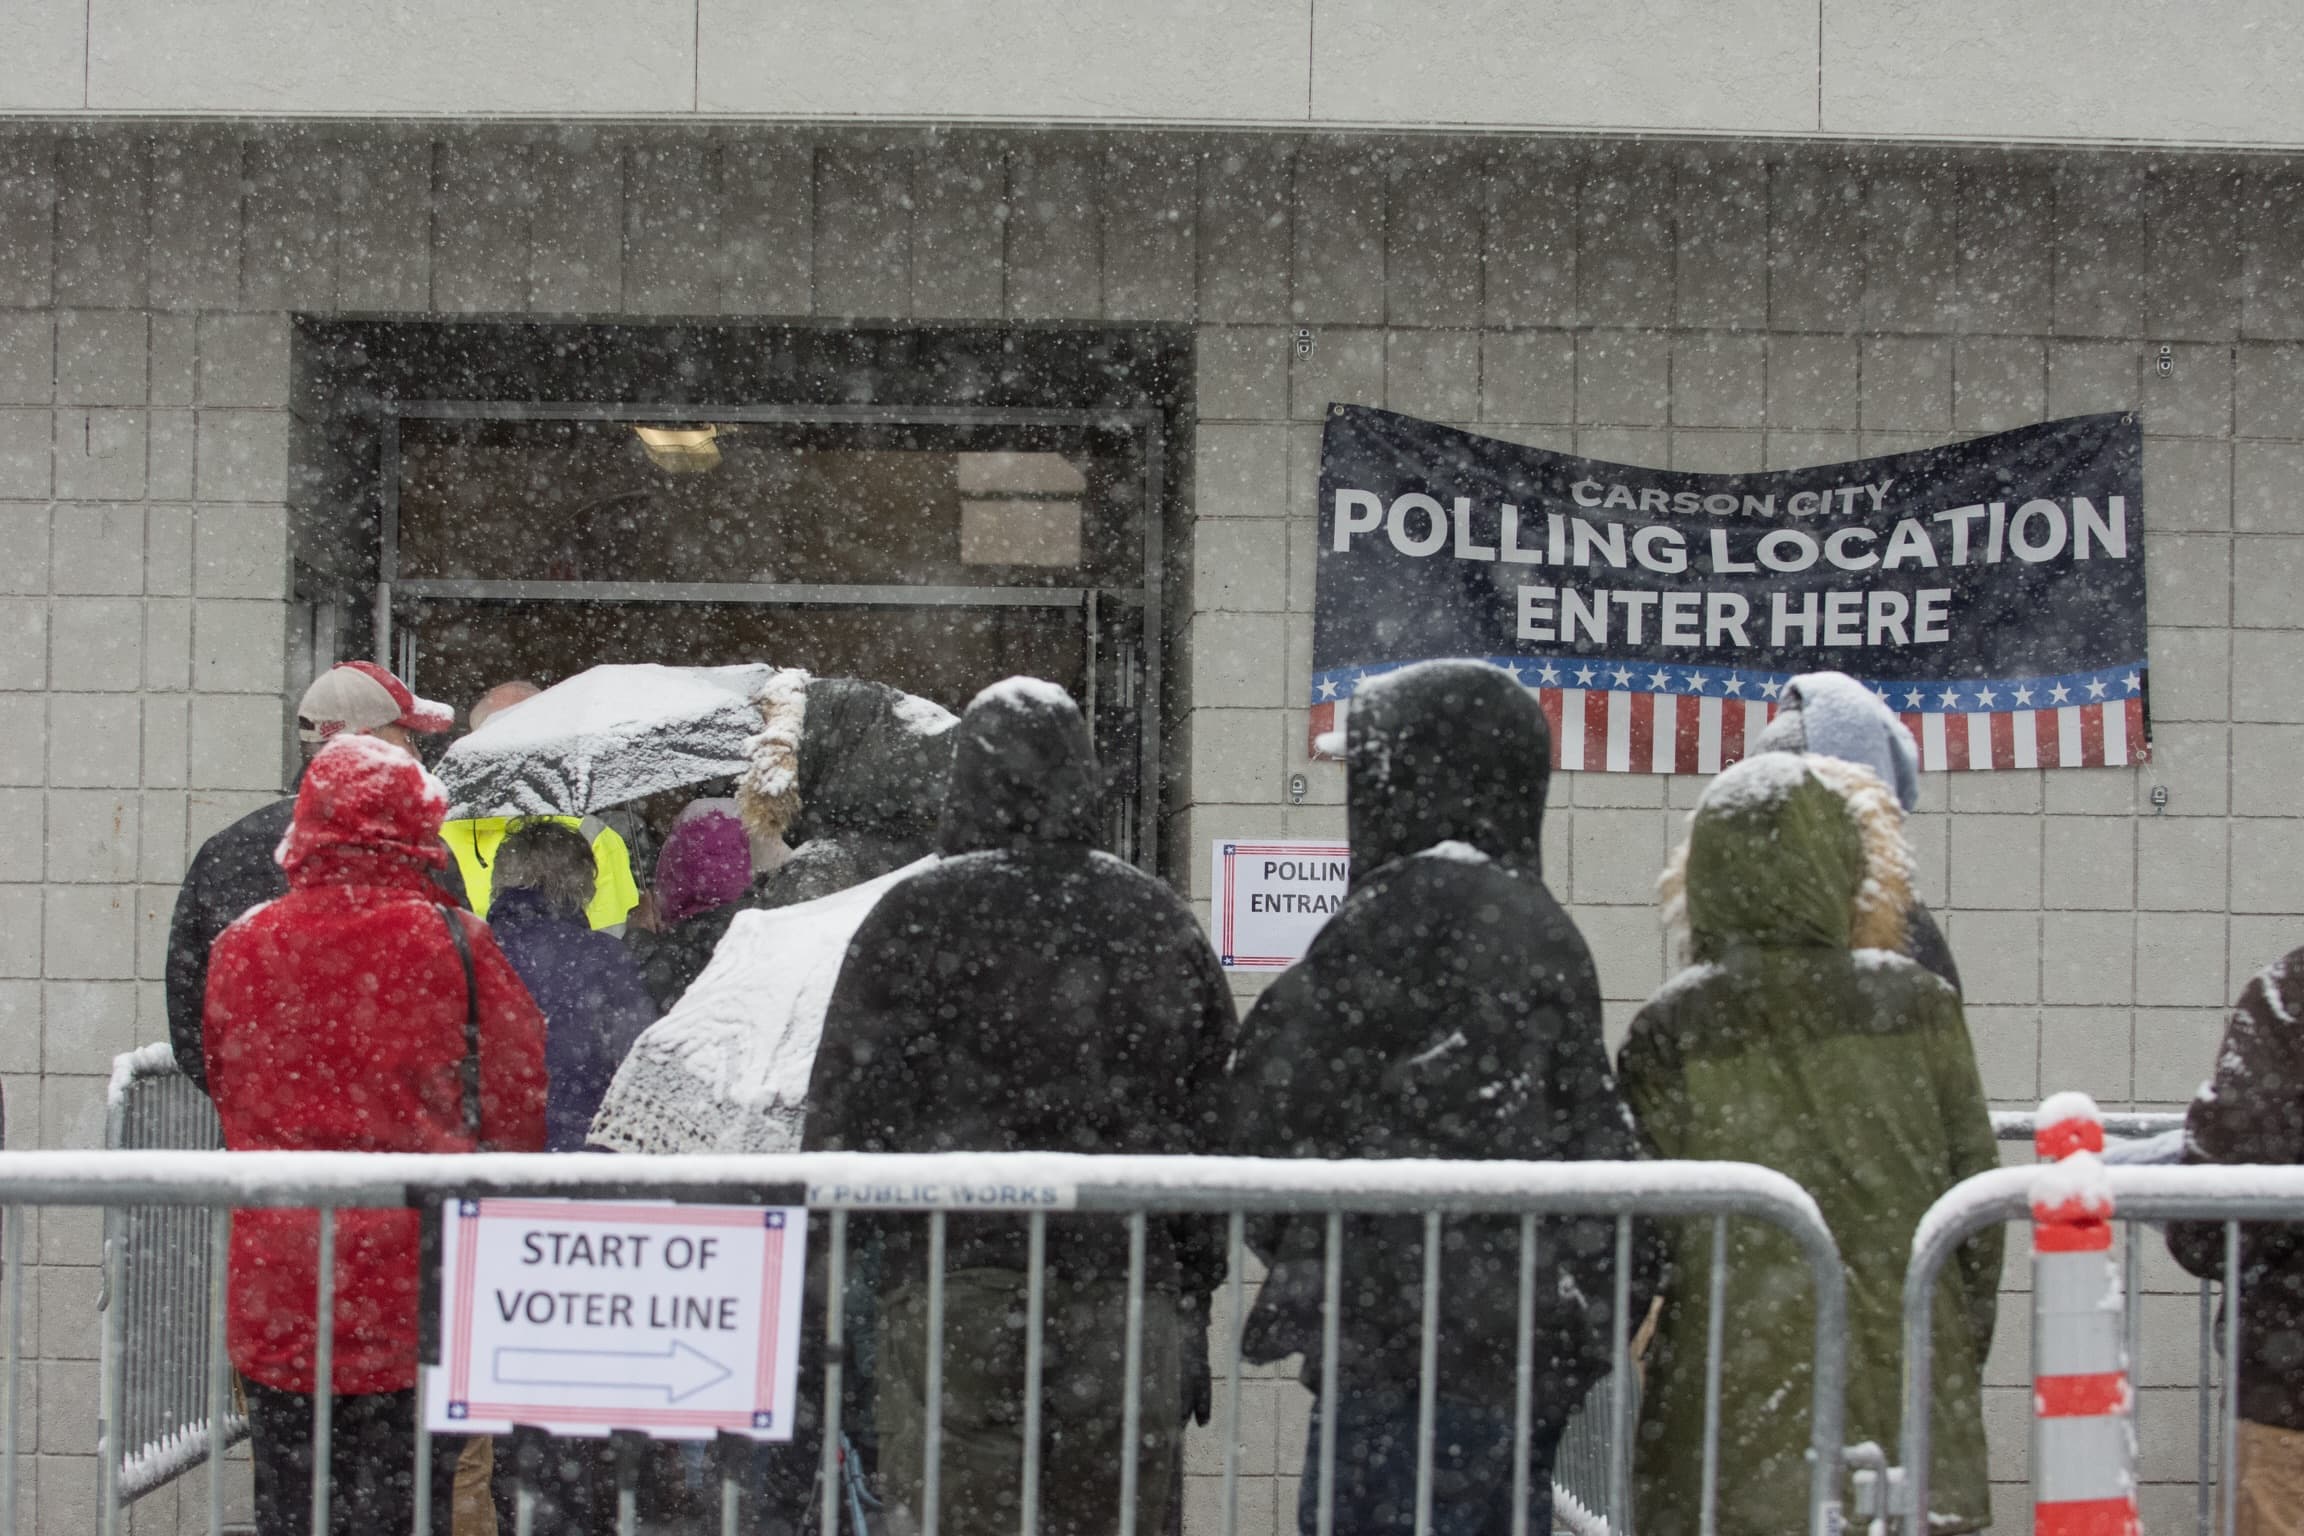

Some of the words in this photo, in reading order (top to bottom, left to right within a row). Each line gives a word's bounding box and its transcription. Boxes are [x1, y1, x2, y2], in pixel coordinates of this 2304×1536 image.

[1571, 480, 1775, 517] CARSON
[1787, 479, 1894, 516] CITY
[1333, 488, 1688, 573] POLLING
[1710, 496, 2127, 573] LOCATION
[1517, 585, 1750, 647] ENTER
[1771, 588, 1951, 647] HERE
[1264, 861, 1350, 881] POLLIN
[834, 1184, 939, 1204] PUBLIC
[951, 1184, 1058, 1205] WORKS
[522, 1231, 650, 1269] START
[664, 1237, 718, 1270] OF
[495, 1288, 633, 1327] VOTER
[649, 1294, 740, 1330] LINE
